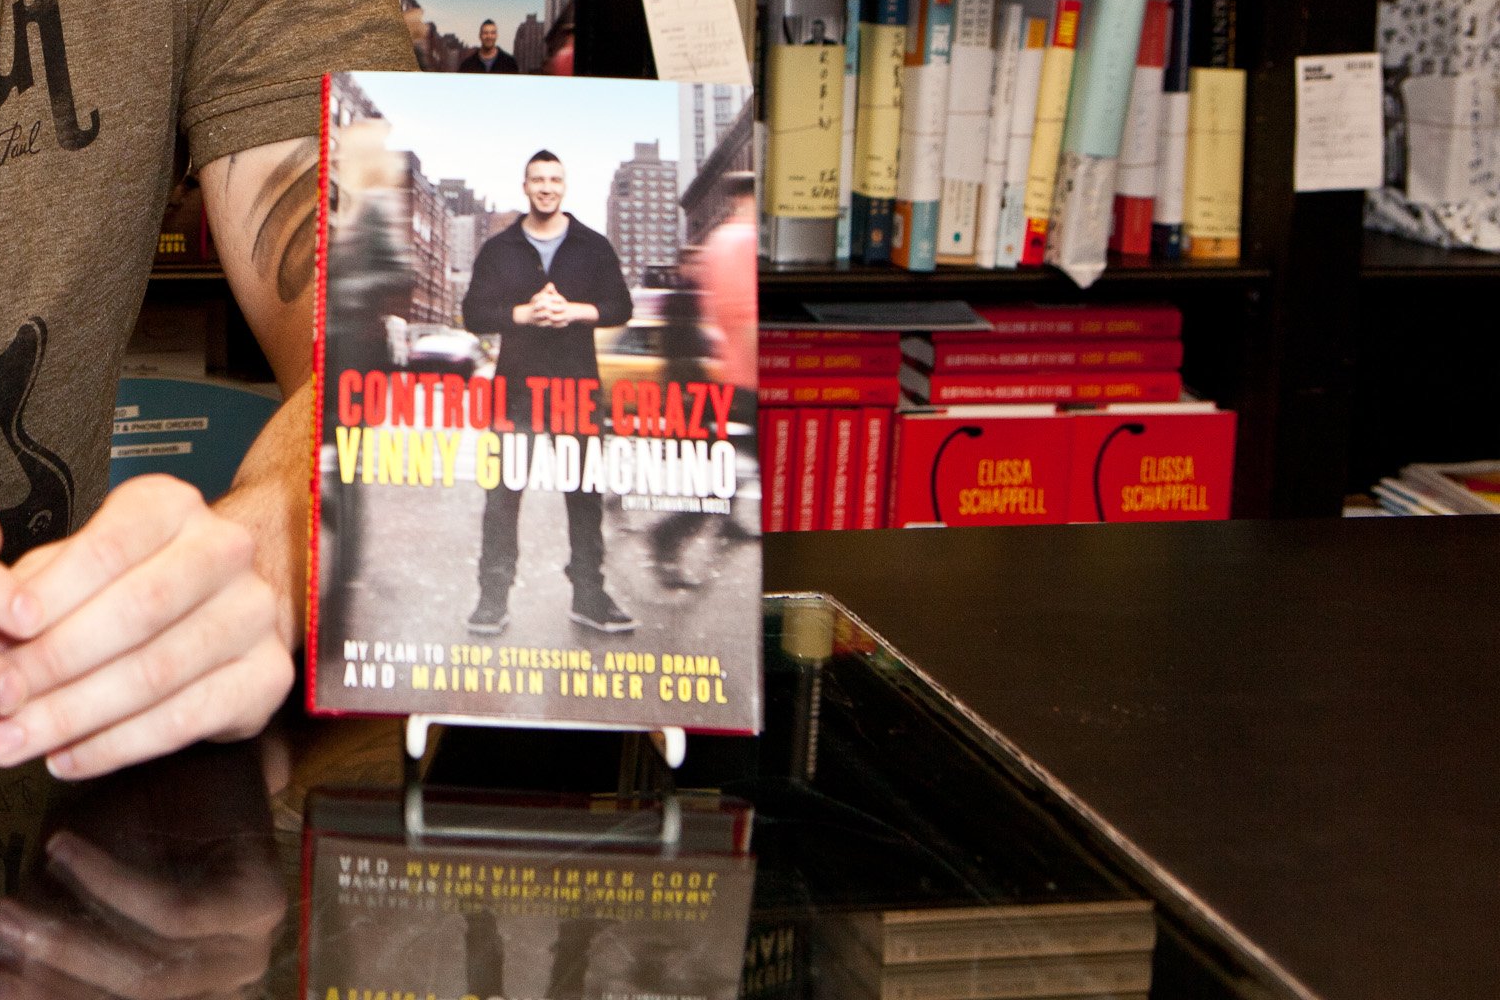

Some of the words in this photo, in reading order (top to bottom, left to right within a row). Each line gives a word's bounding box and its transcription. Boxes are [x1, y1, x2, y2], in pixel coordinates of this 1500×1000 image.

[338, 368, 516, 432] CONTROL
[525, 375, 600, 436] THE
[611, 378, 736, 440] CRAZY
[335, 426, 462, 488] VINNY
[475, 431, 736, 500] GUADAGNINO
[977, 459, 1033, 487] ELISSA
[1140, 455, 1195, 484] ELISSA
[343, 639, 369, 663] MY
[374, 641, 418, 664] PLAN
[424, 643, 445, 666] TO
[451, 644, 493, 667] STOP
[499, 646, 599, 673] STRESSING,
[604, 651, 656, 675] AVOID
[661, 653, 728, 681] DRAMA,
[343, 661, 396, 690] AND
[411, 664, 544, 696] MAINTAIN
[560, 670, 644, 701] INNER
[658, 674, 728, 705] COOL
